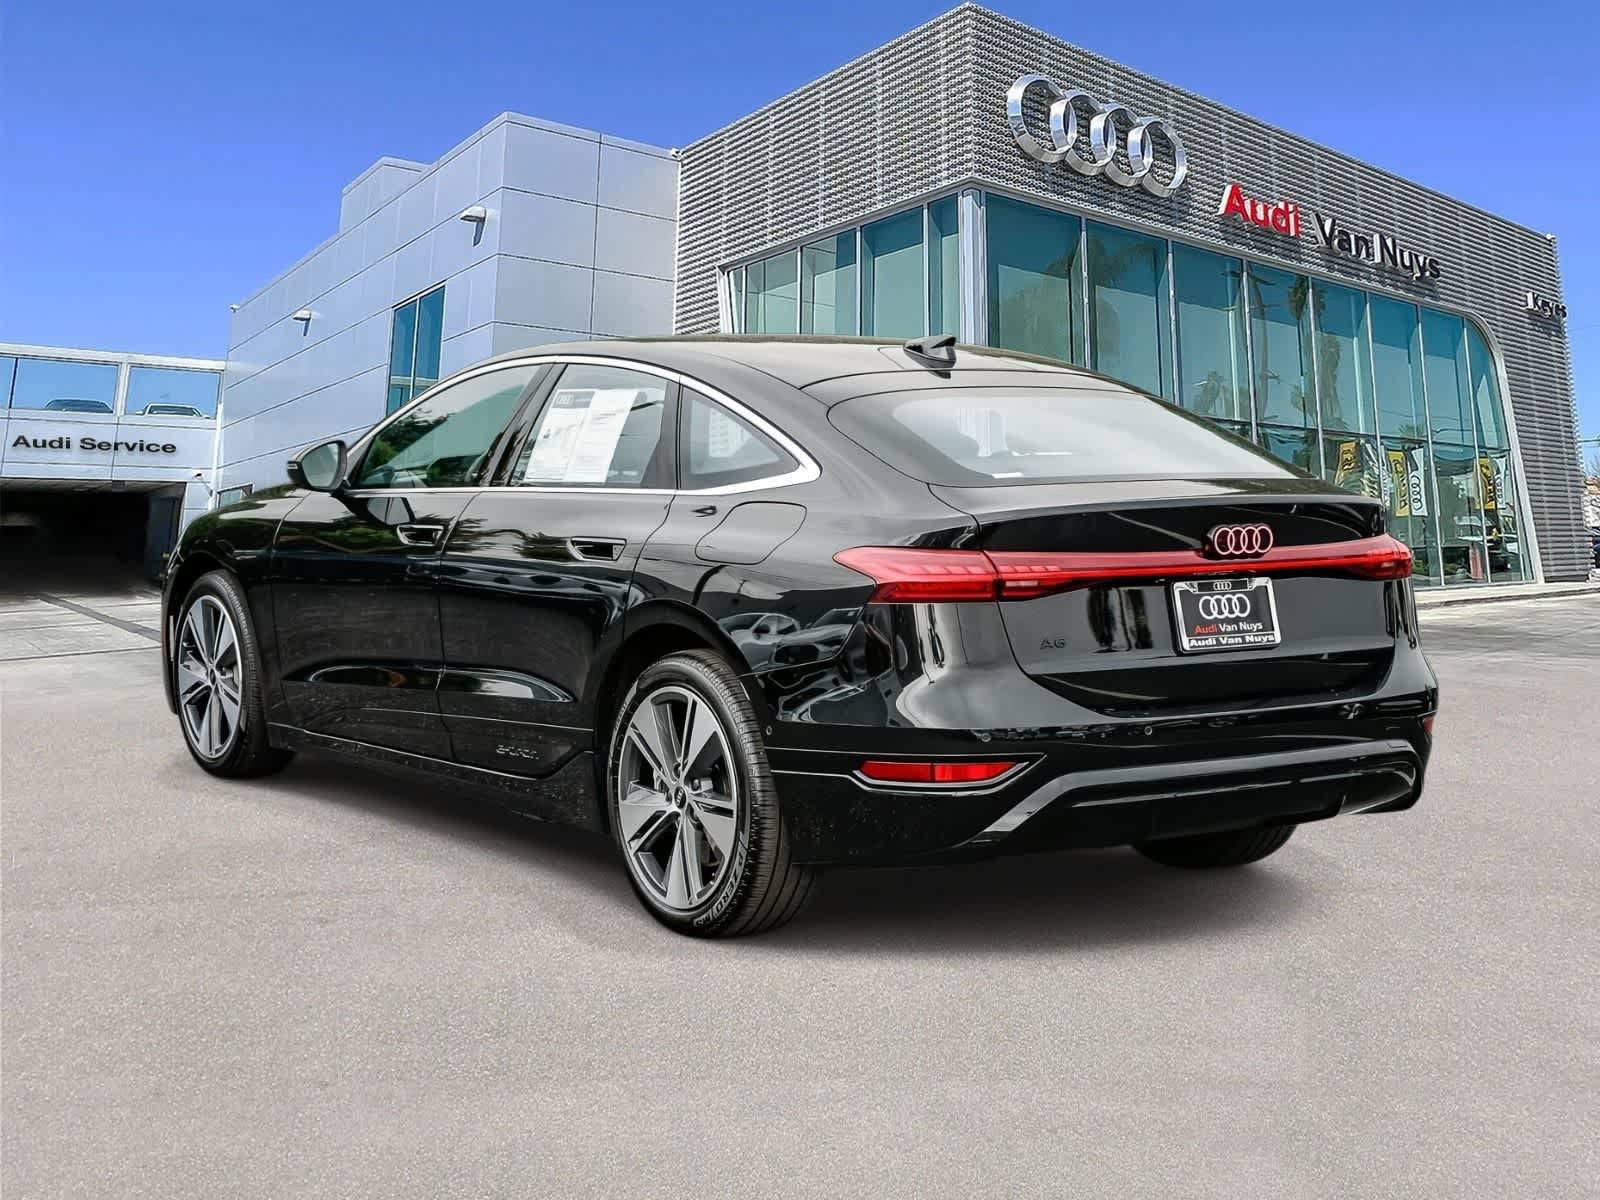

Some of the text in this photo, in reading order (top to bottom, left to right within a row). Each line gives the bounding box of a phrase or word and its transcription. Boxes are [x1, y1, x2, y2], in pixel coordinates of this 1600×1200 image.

[1217, 183, 1441, 280] Audi Van Nuys
[12, 435, 178, 454] Audi Service
[1195, 621, 1263, 634] Audi Van Nuys
[1190, 633, 1276, 648] Audi Van Nuys
